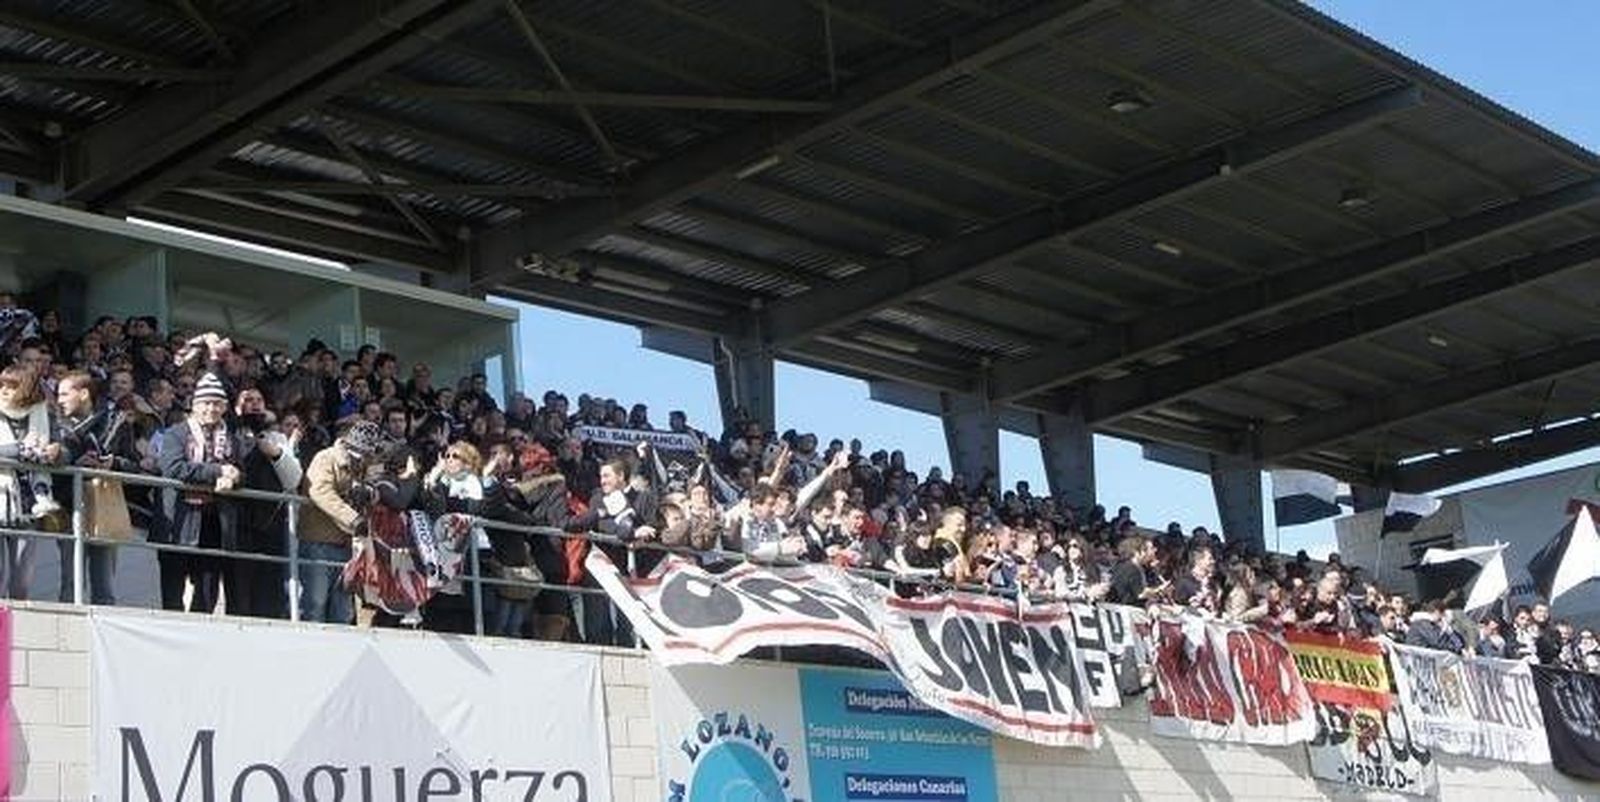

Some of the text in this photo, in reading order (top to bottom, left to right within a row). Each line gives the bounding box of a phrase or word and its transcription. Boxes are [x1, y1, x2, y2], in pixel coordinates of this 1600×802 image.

[908, 610, 1086, 716] JOVEN
[119, 727, 588, 802] Moguerza
[848, 776, 966, 796] Delegaciones Canarias
